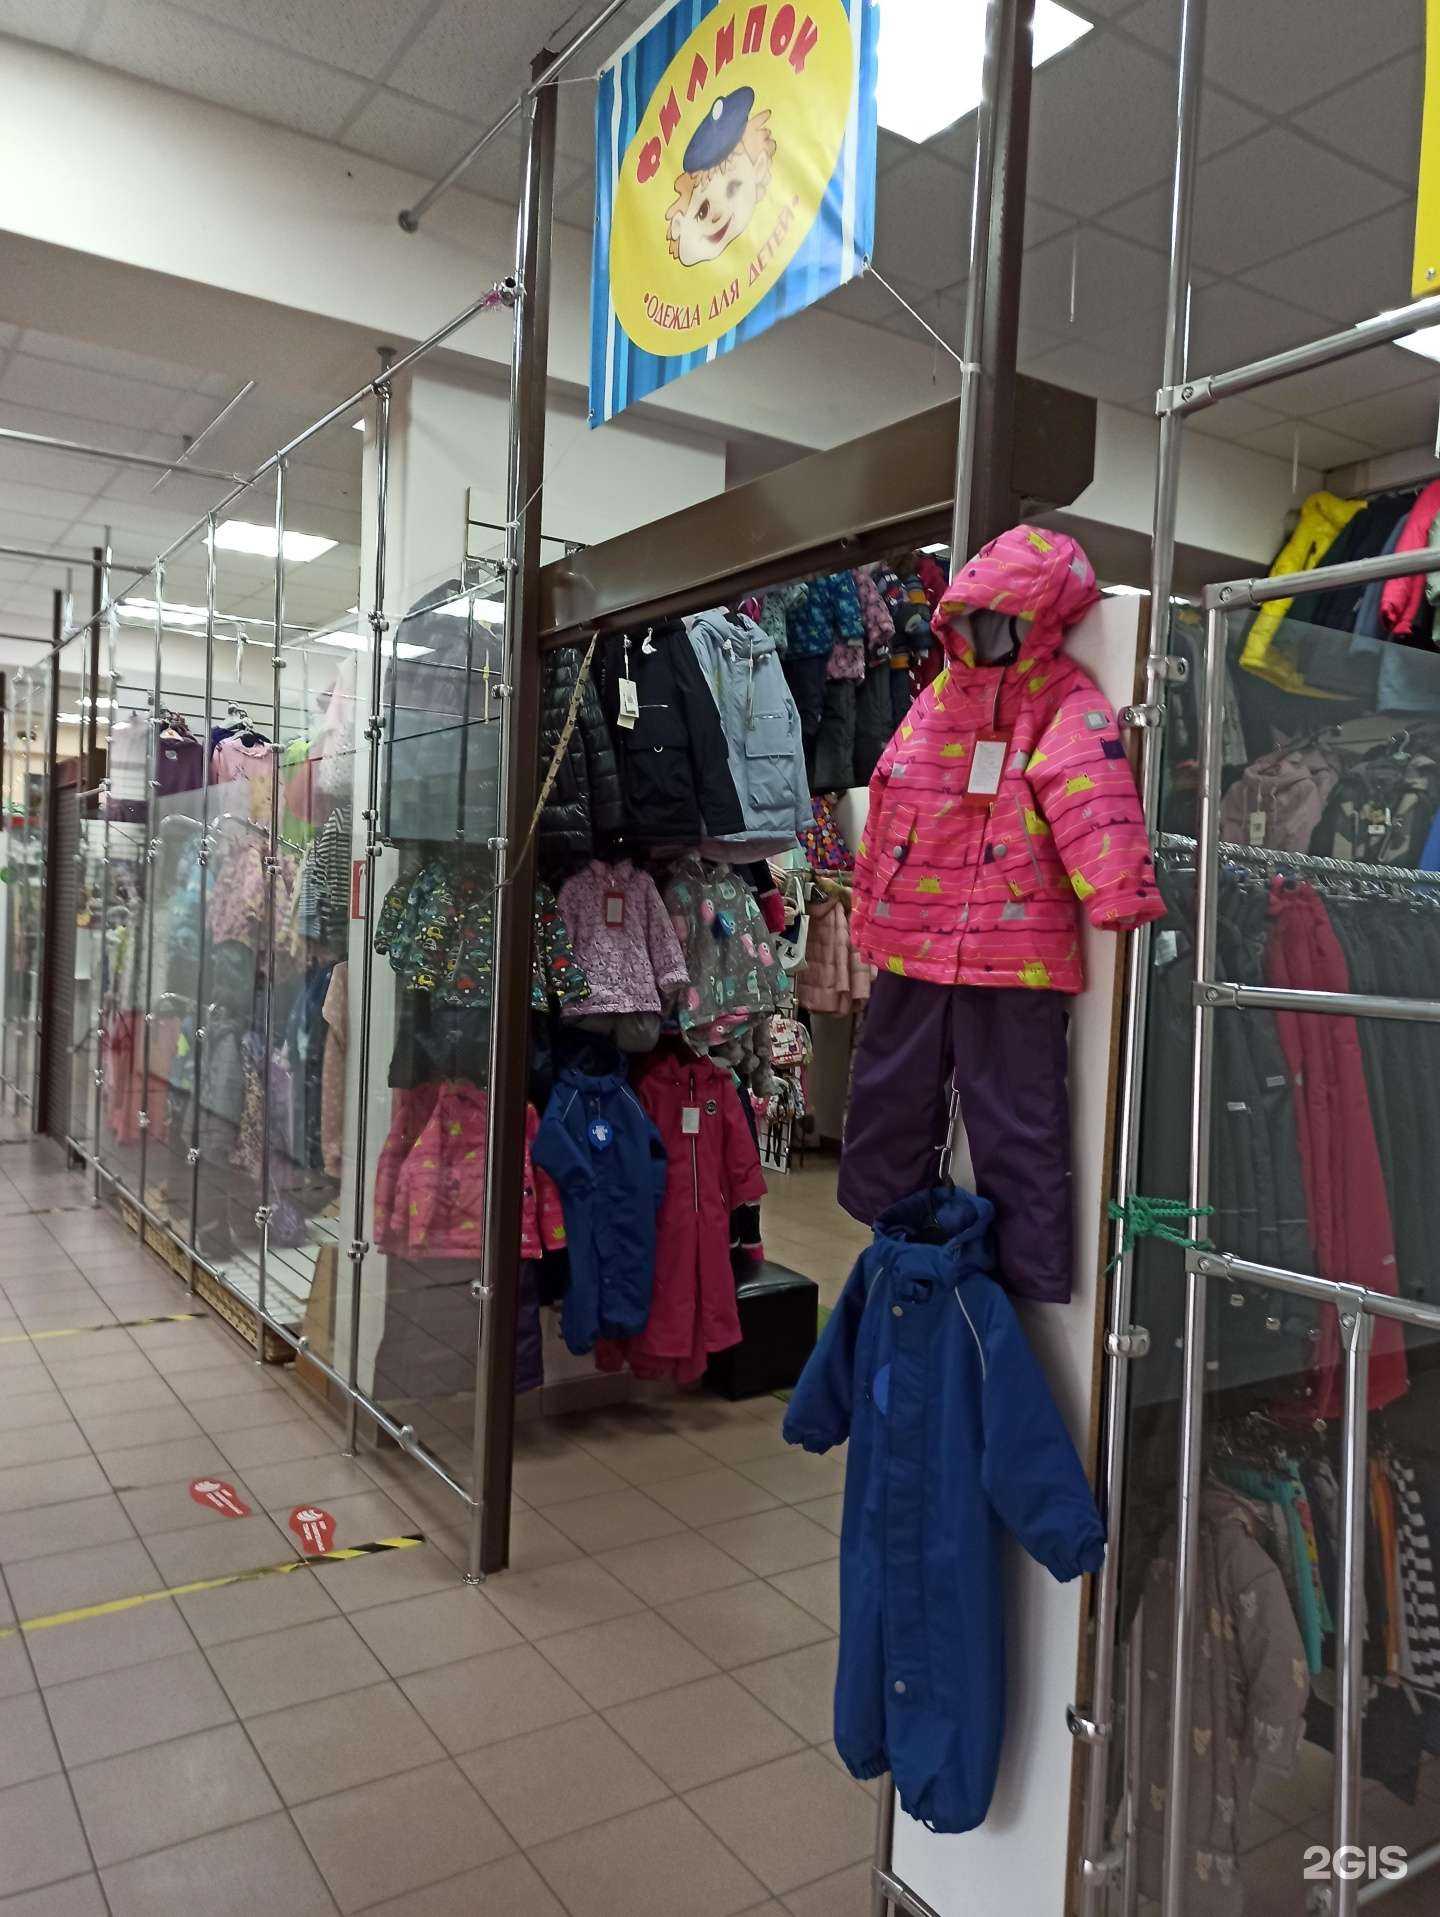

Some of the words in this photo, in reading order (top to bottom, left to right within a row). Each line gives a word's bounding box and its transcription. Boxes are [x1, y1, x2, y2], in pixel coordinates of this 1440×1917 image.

[635, 3, 819, 184] ФИЛИПОК
[646, 294, 701, 330] ОДЕЖДА
[708, 278, 740, 320] ДЛЯ
[748, 203, 795, 287] ДЕТЕЙ
